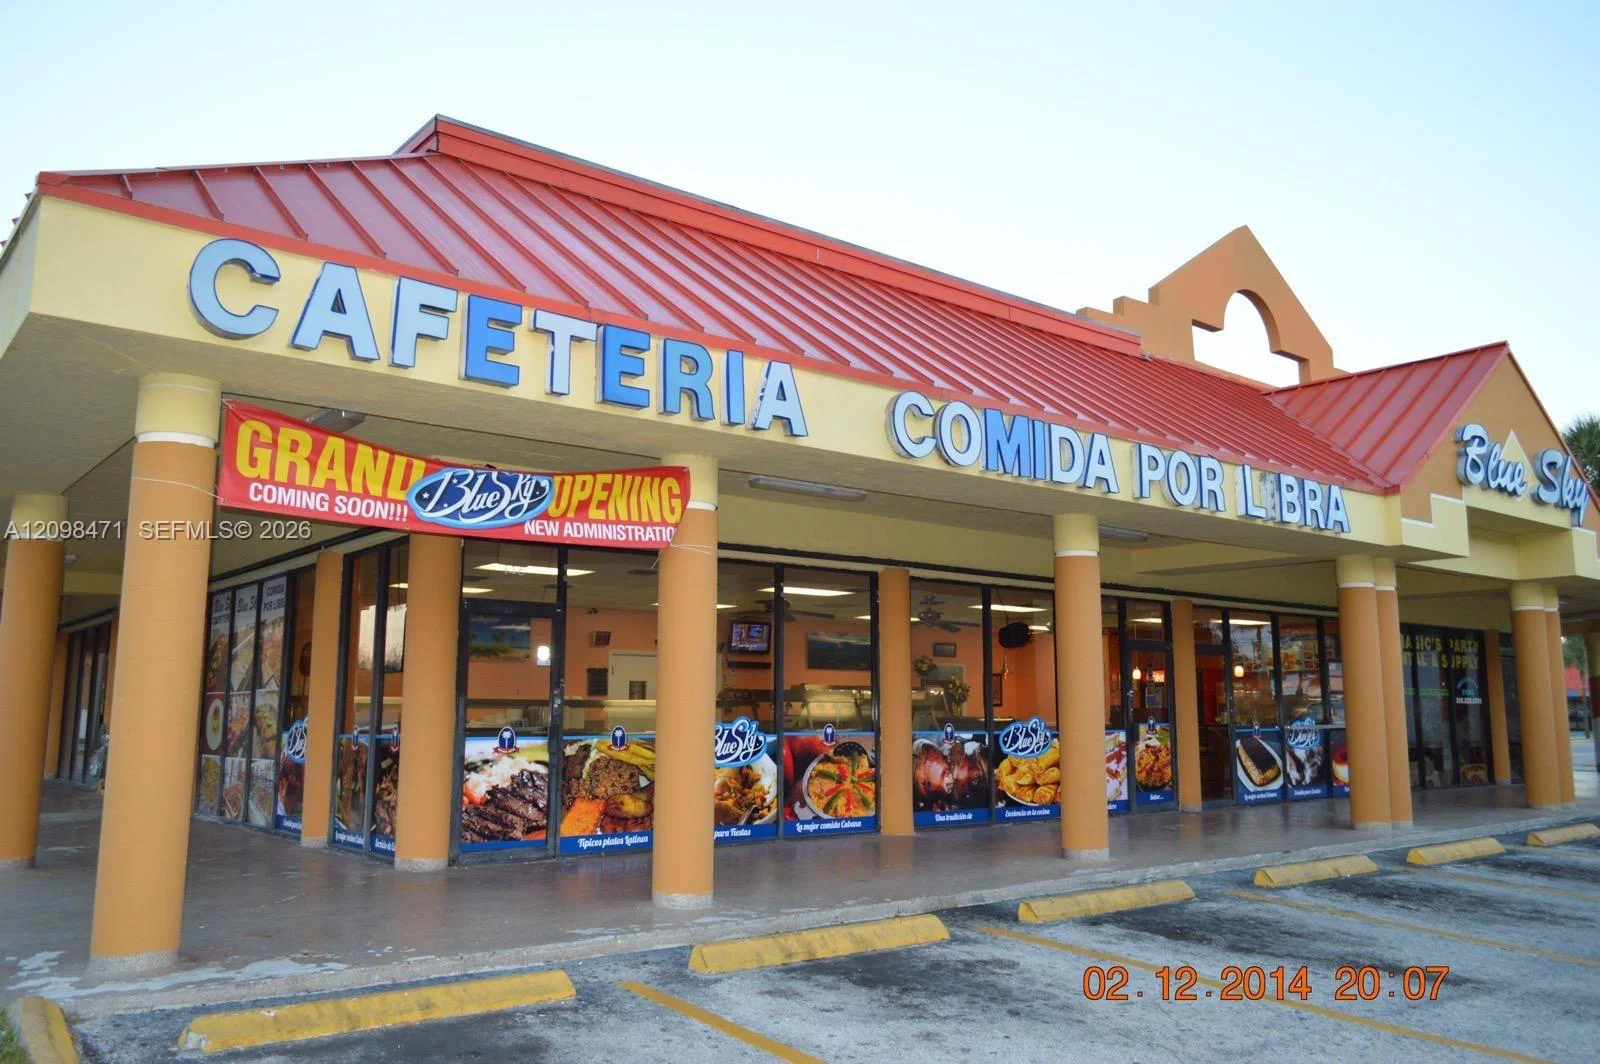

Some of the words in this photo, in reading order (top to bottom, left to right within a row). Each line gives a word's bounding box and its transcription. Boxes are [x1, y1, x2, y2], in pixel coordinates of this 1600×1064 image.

[188, 238, 808, 437] CAFETERIA
[235, 420, 425, 500] GRAND
[885, 391, 1119, 493] COMIDA
[1132, 443, 1226, 512] POR
[1454, 424, 1528, 496] Blue
[1531, 448, 1589, 527] Sky
[249, 482, 329, 512] COMING
[334, 495, 408, 521] SOON!!!
[548, 473, 682, 523] OPENING
[524, 519, 560, 537] NEW
[602, 836, 624, 848] platos
[624, 834, 649, 846] Latinos
[730, 827, 751, 837] Fiestas
[803, 821, 819, 832] mejor
